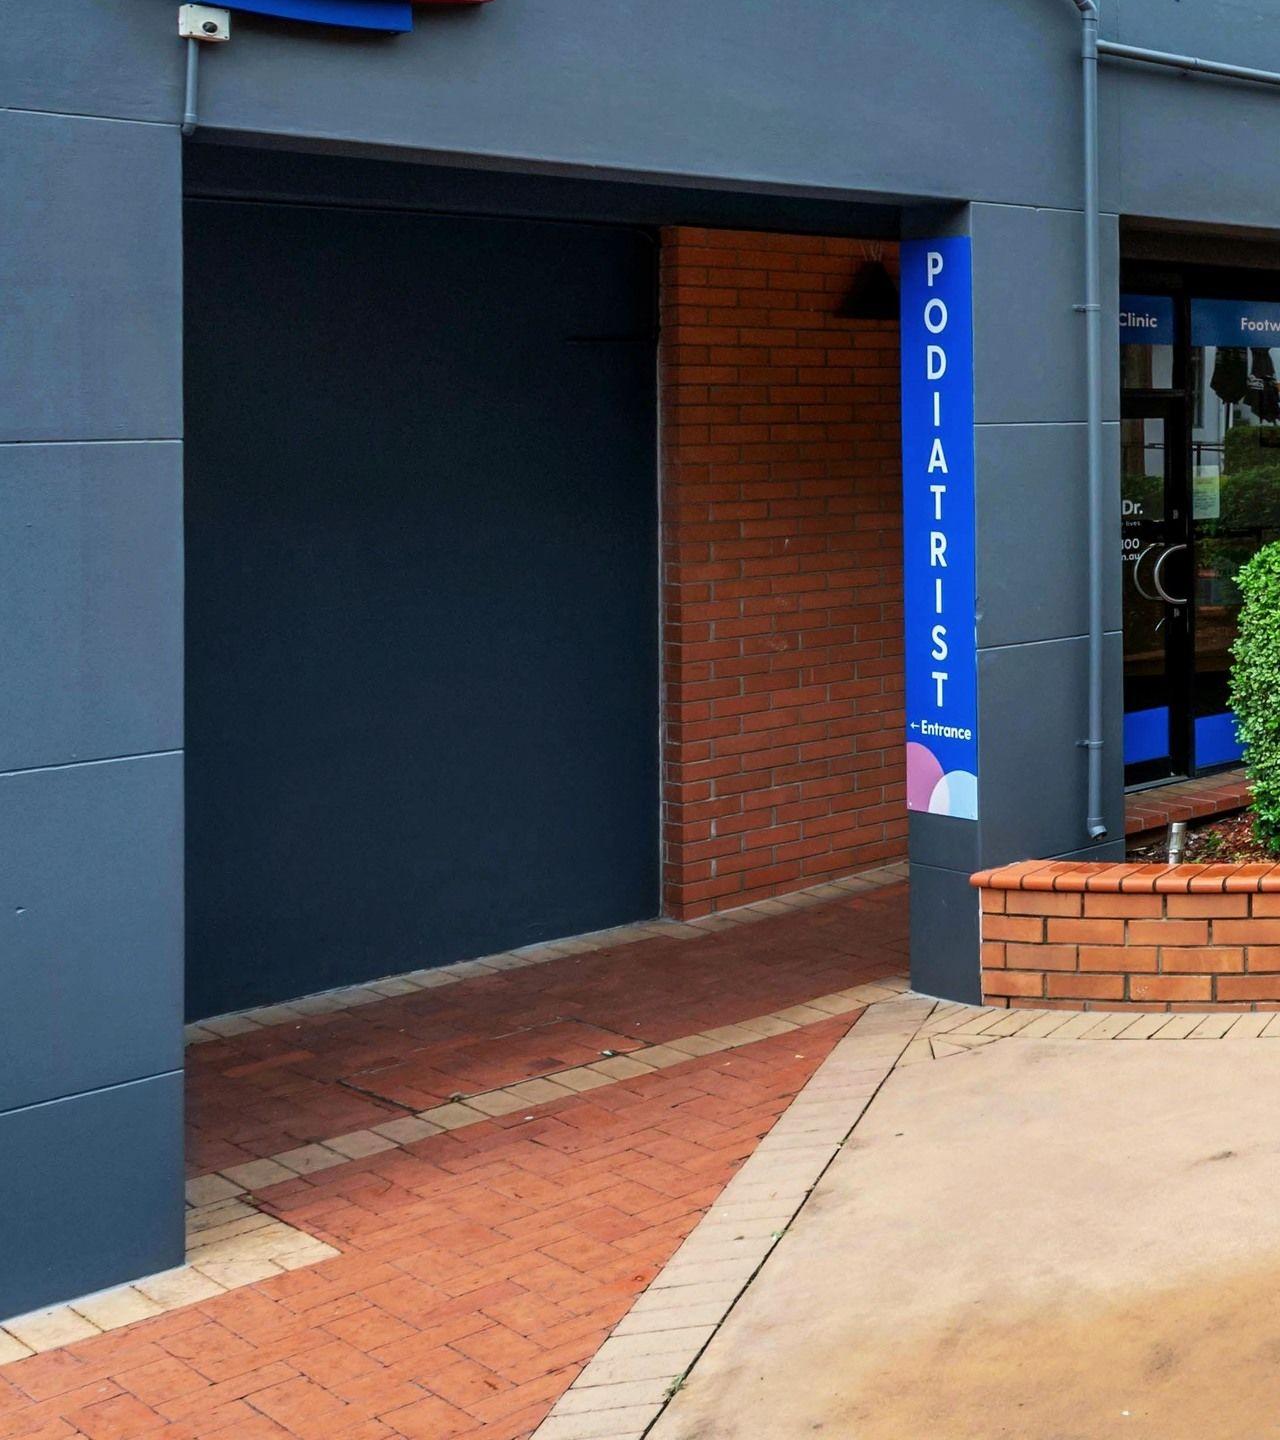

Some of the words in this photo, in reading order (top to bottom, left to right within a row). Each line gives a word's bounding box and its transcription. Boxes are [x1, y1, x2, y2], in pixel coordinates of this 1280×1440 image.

[1119, 312, 1158, 328] Clinic
[923, 251, 949, 708] PODIATRIST
[921, 719, 972, 740] Entrance
